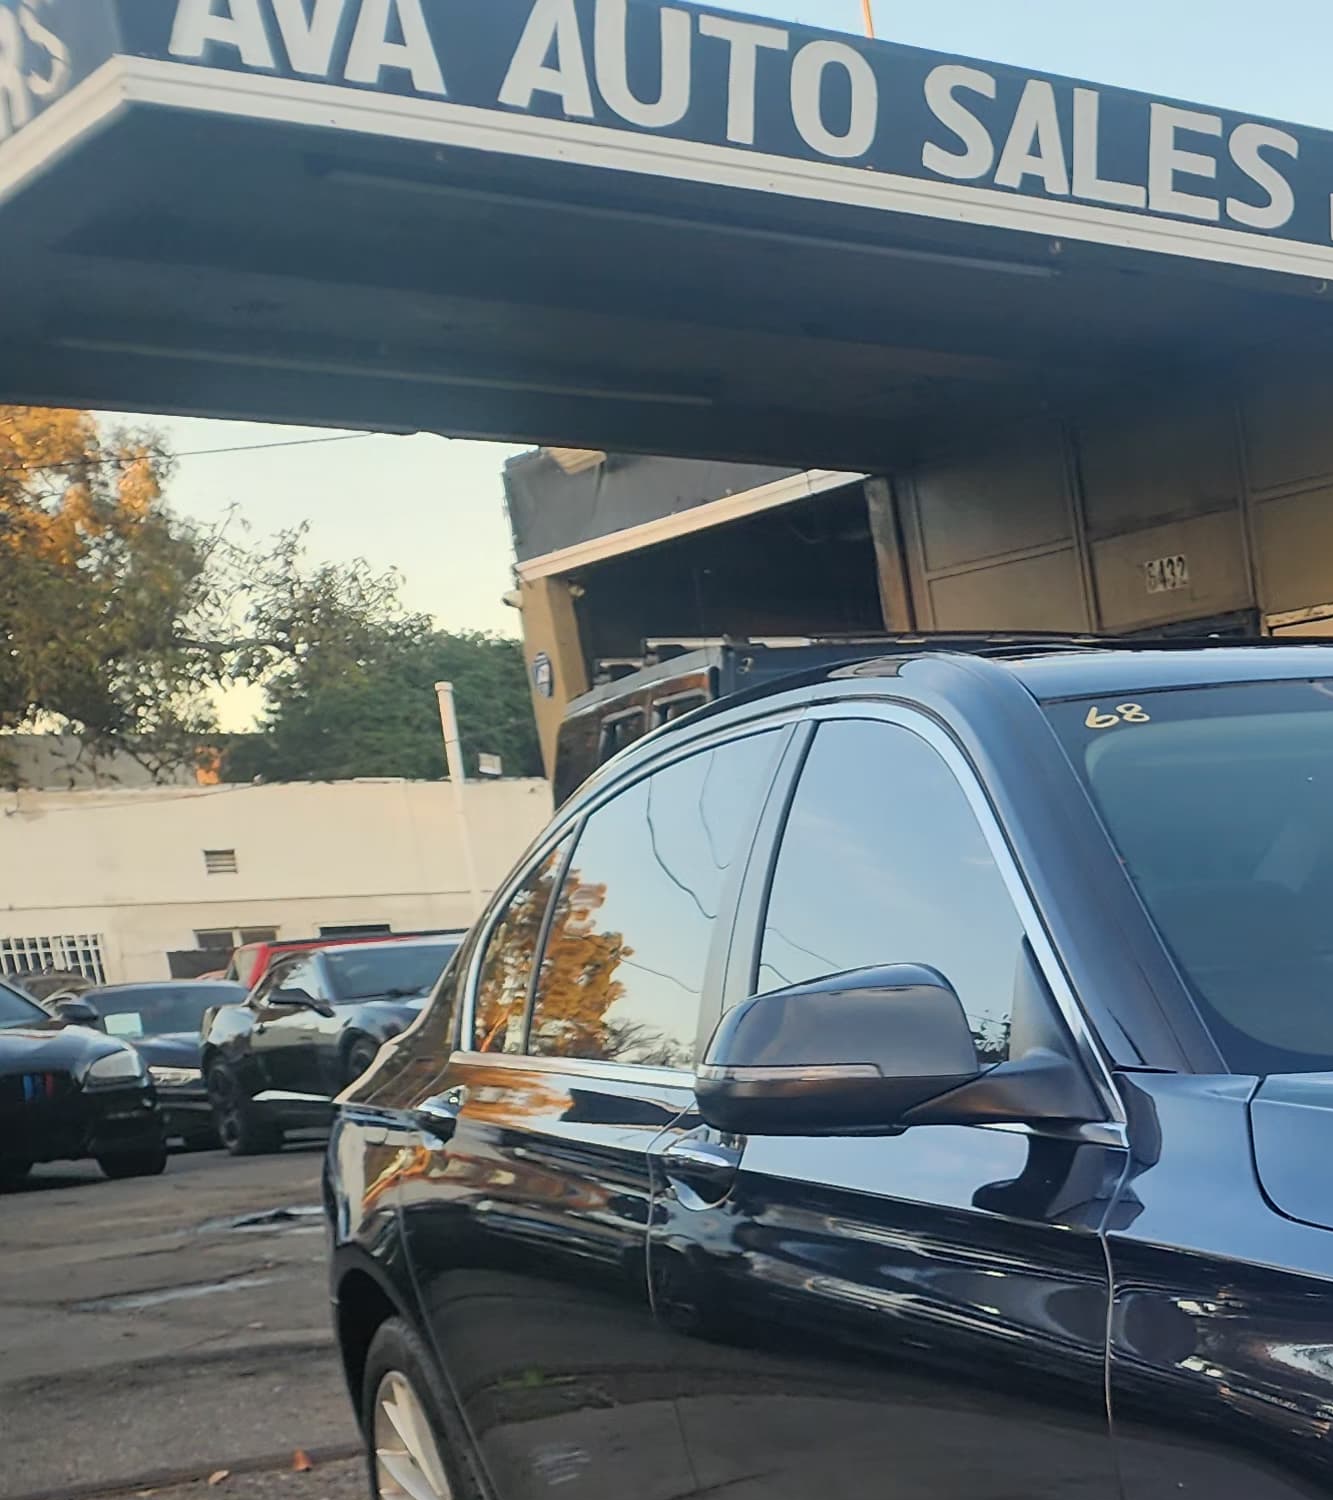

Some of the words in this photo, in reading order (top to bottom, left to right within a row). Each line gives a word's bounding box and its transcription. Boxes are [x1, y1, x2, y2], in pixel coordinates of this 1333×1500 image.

[168, 0, 449, 96] AVA
[498, 0, 879, 159] AUTO
[922, 64, 1299, 231] SALES
[1084, 703, 1151, 729] 68
